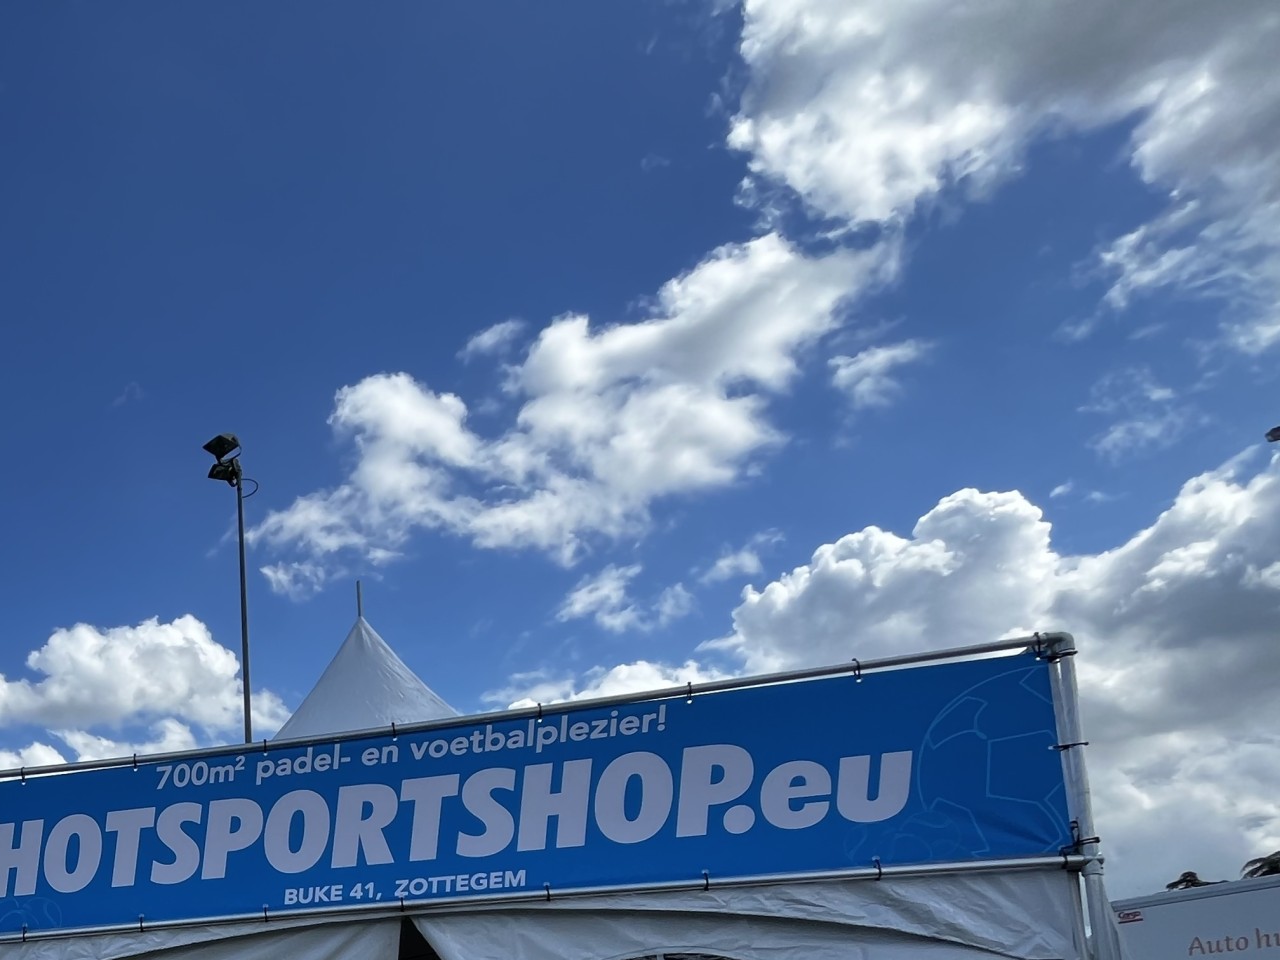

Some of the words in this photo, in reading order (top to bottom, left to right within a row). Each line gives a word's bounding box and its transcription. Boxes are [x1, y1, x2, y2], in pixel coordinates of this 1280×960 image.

[256, 744, 351, 785] padel-
[362, 741, 398, 765] en
[410, 704, 667, 760] voetbalplezier!
[284, 884, 343, 905] BUKE
[349, 881, 382, 901] 41,
[395, 869, 526, 897] ZOTTEGEM
[1188, 935, 1249, 956] Auto
